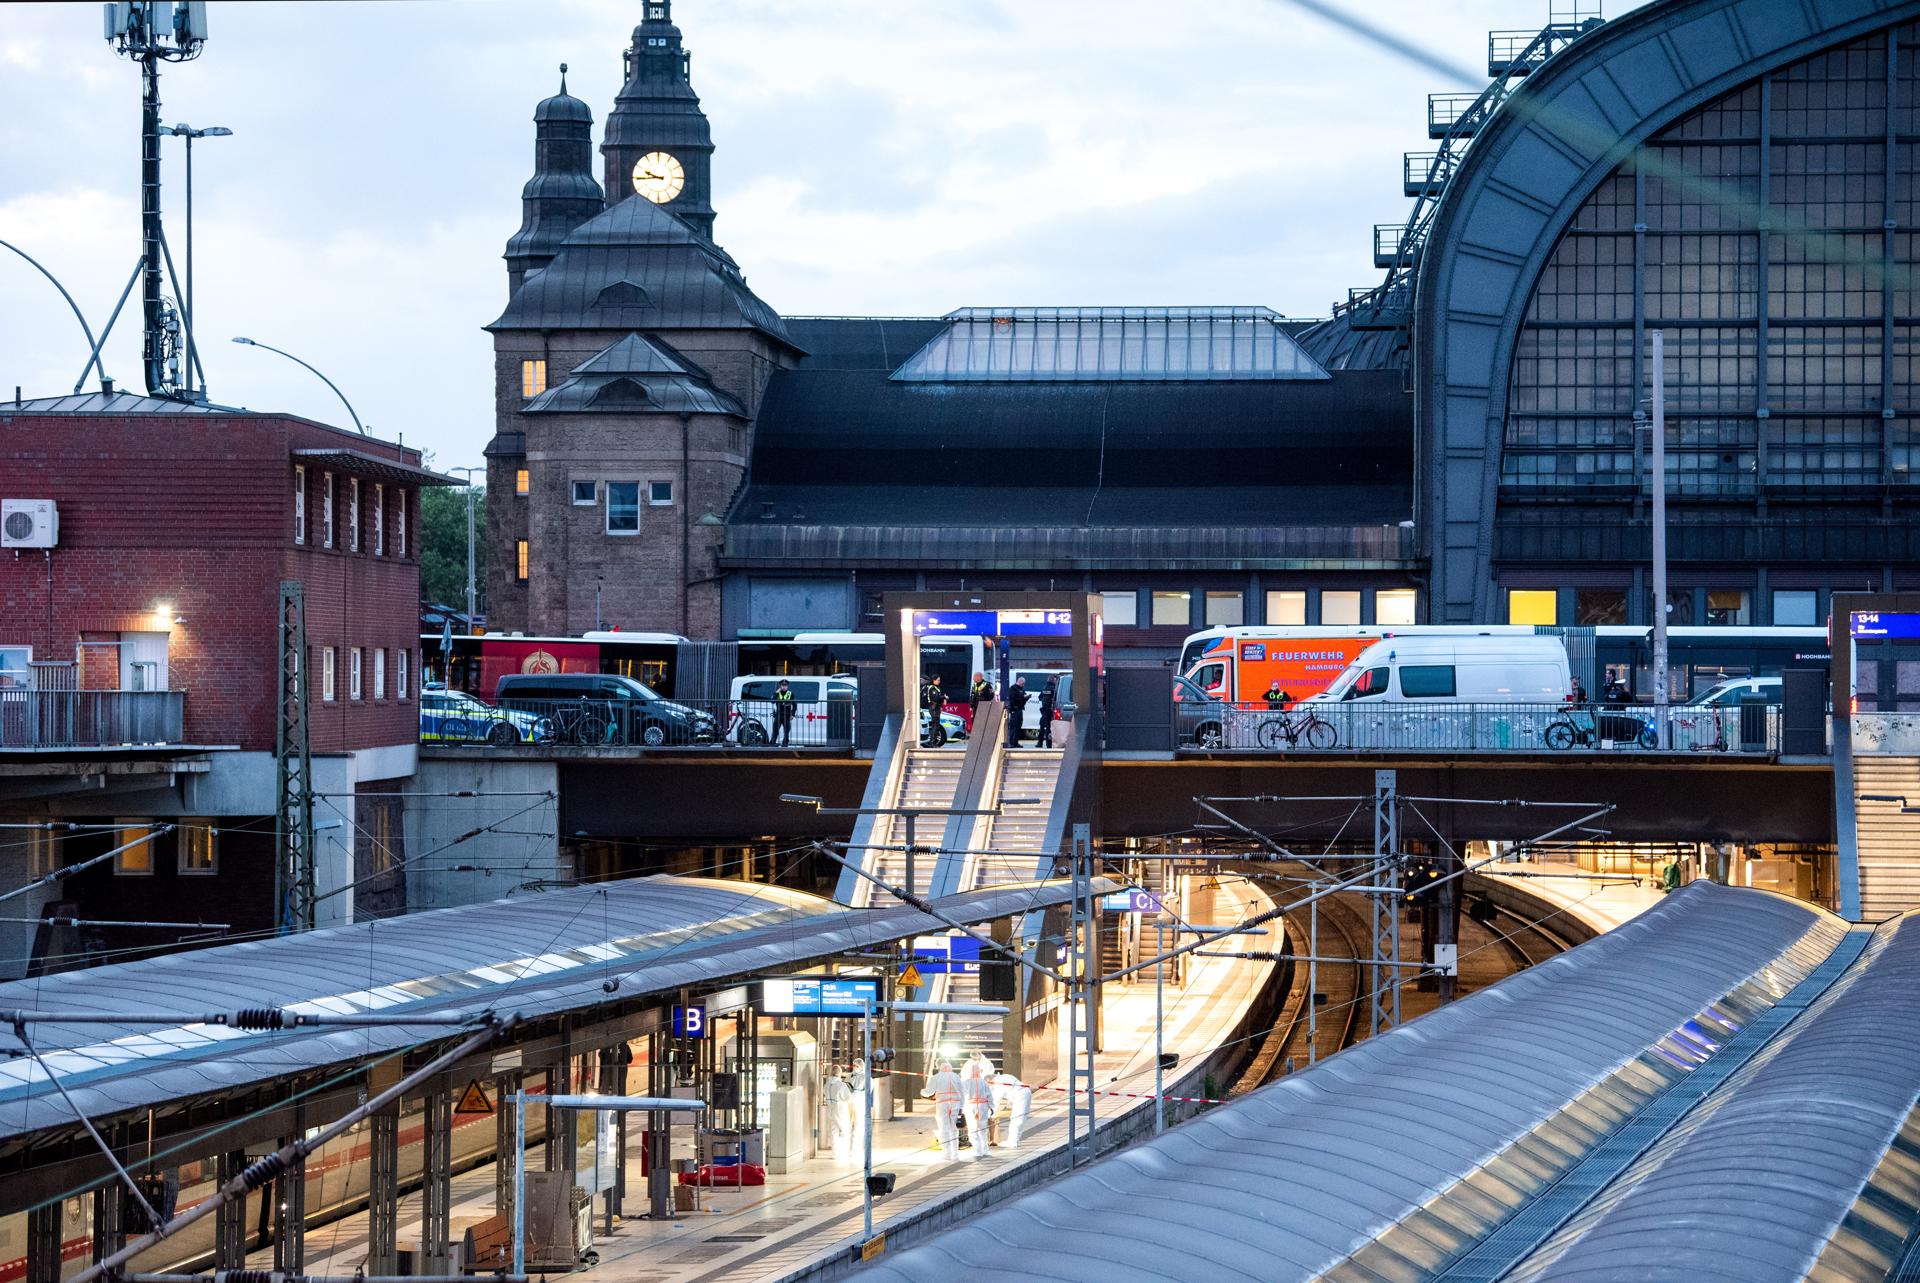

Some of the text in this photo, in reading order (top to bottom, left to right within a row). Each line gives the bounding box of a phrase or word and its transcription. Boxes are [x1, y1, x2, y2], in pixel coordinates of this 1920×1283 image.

[1857, 614, 1879, 623] 13-14
[1271, 651, 1344, 661] FEUERWEHR
[1136, 892, 1148, 909] C
[687, 1008, 701, 1031] B
